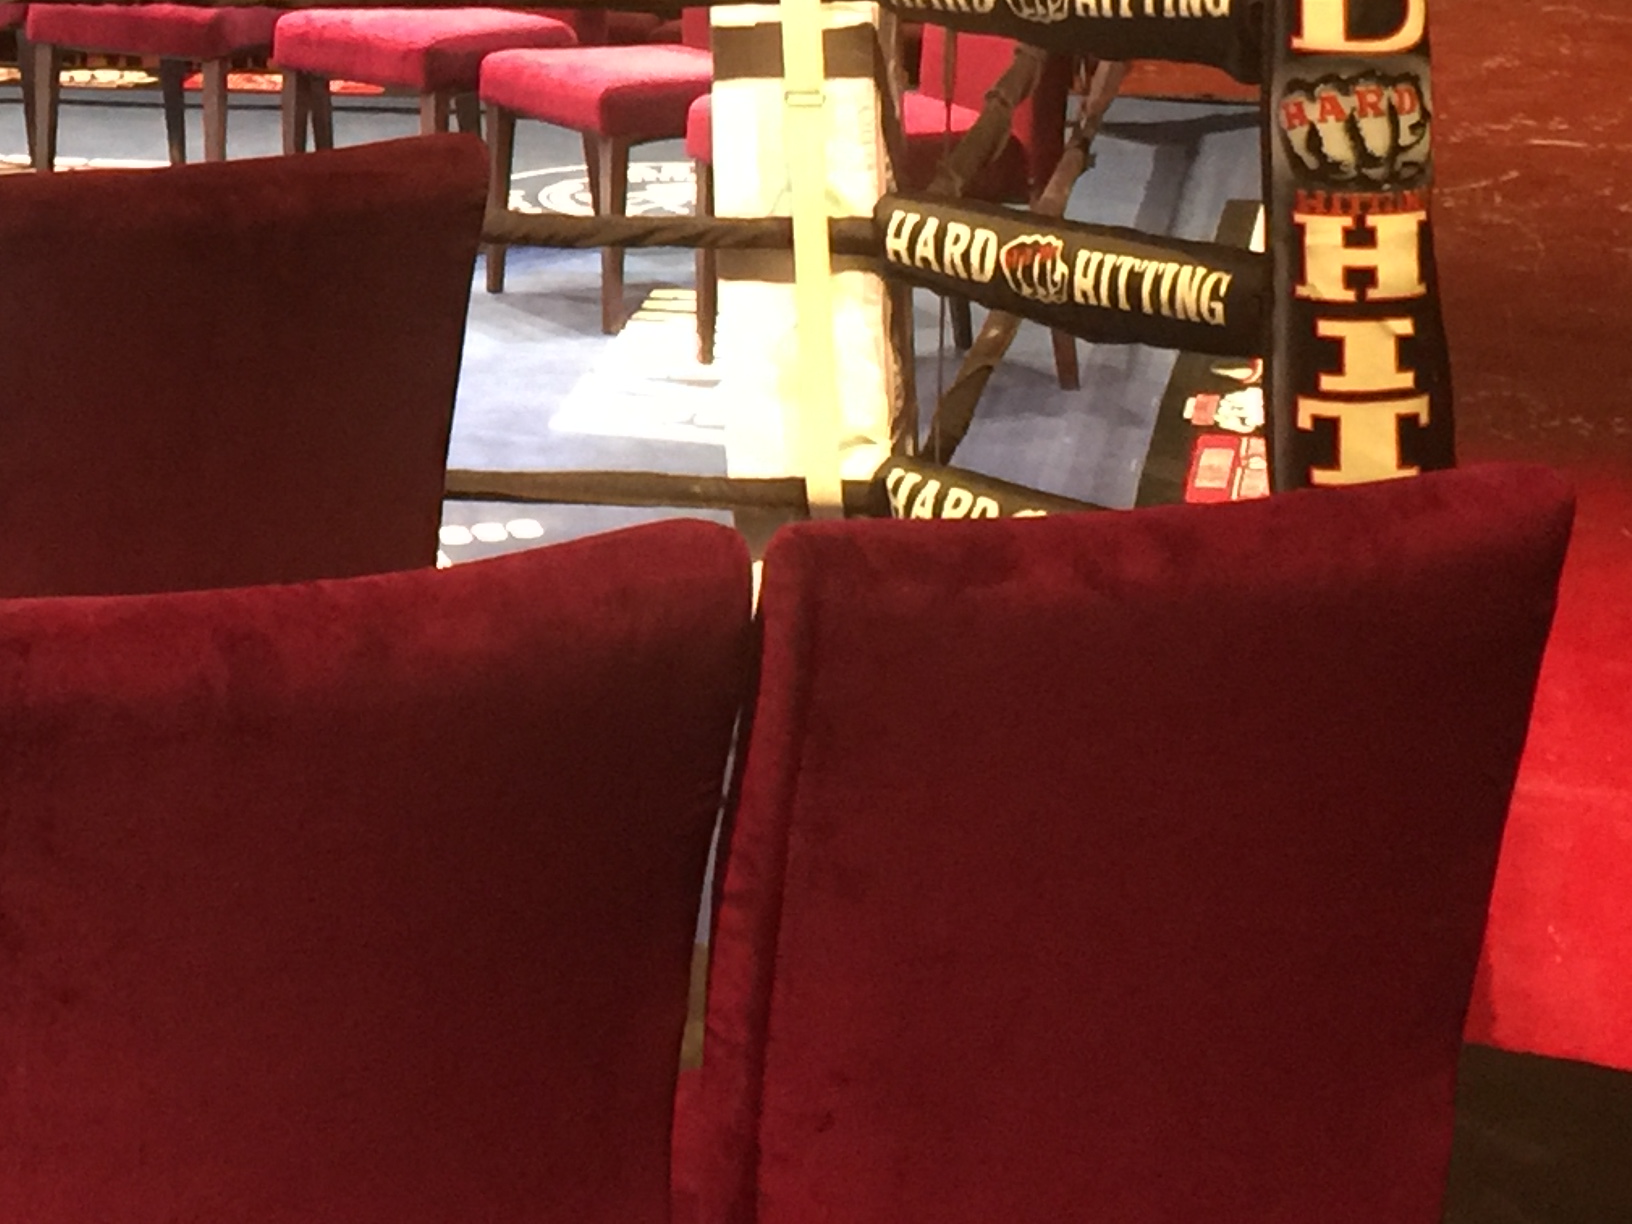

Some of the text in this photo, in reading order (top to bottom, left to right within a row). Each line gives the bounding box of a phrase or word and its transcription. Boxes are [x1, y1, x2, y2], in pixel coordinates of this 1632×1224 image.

[1279, 83, 1419, 131] HARD
[884, 209, 1233, 326] HARD HITTING
